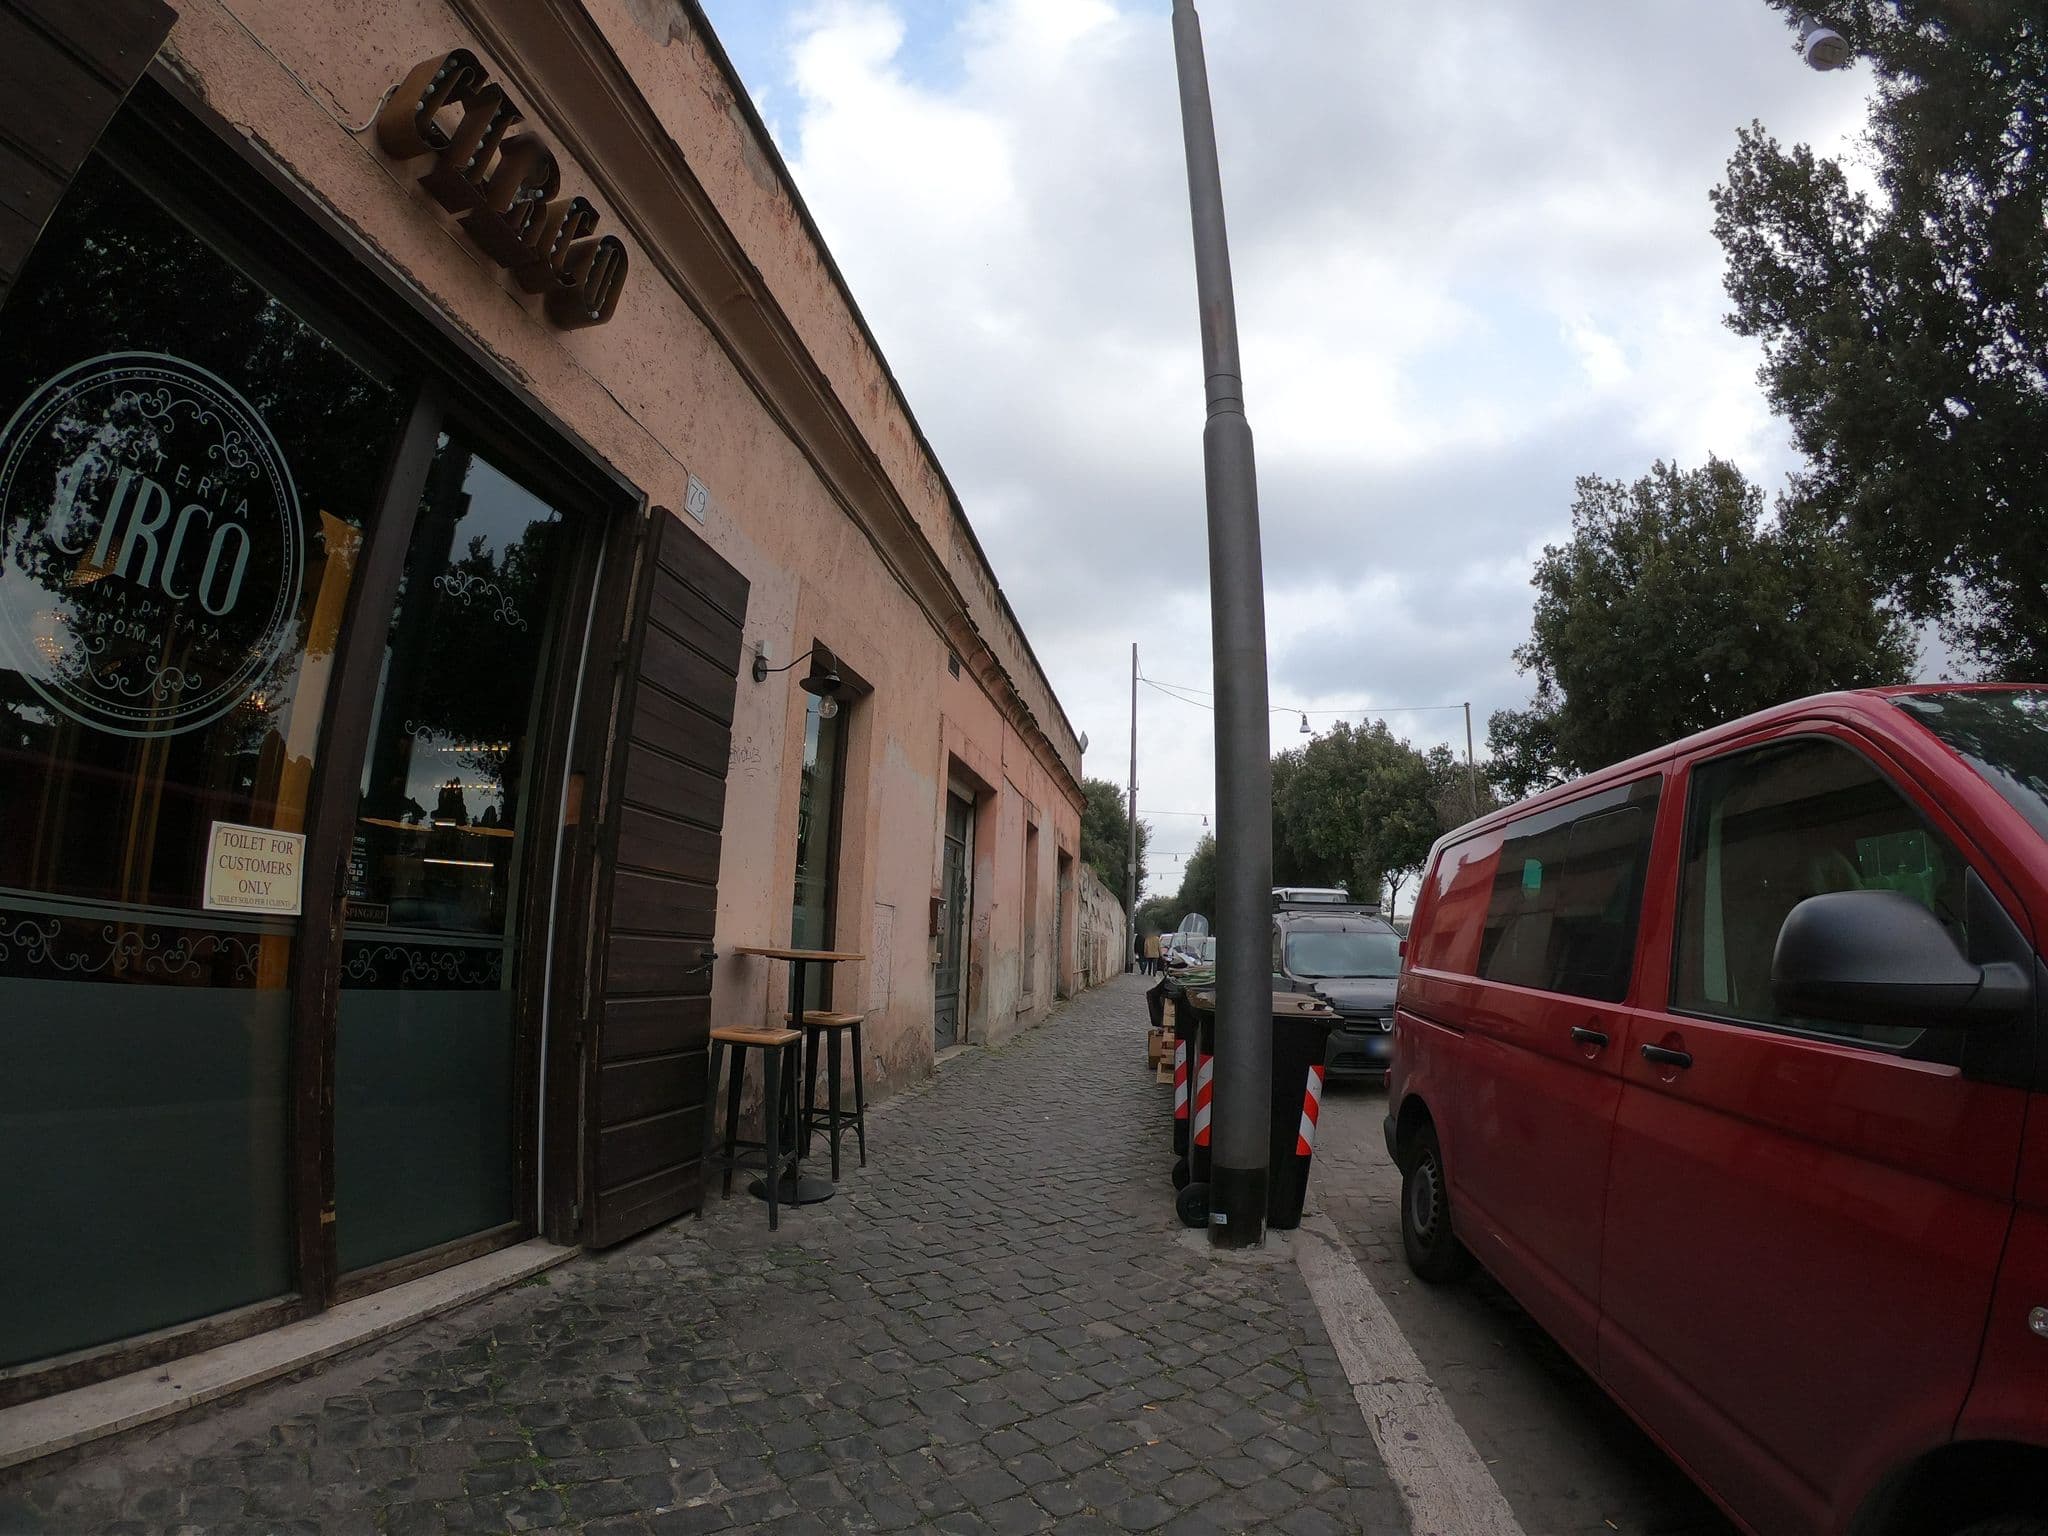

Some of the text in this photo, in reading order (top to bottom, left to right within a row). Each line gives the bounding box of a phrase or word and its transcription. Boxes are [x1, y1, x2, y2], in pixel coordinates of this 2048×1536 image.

[378, 48, 629, 330] CIRCO
[690, 483, 706, 514] 79
[50, 450, 250, 616] CIRCO
[97, 612, 161, 649] ROMA
[174, 613, 220, 641] CASA
[223, 832, 293, 855] TOILET FOR
[219, 854, 292, 876] CUSTOMERS
[238, 879, 271, 895] ONLY
